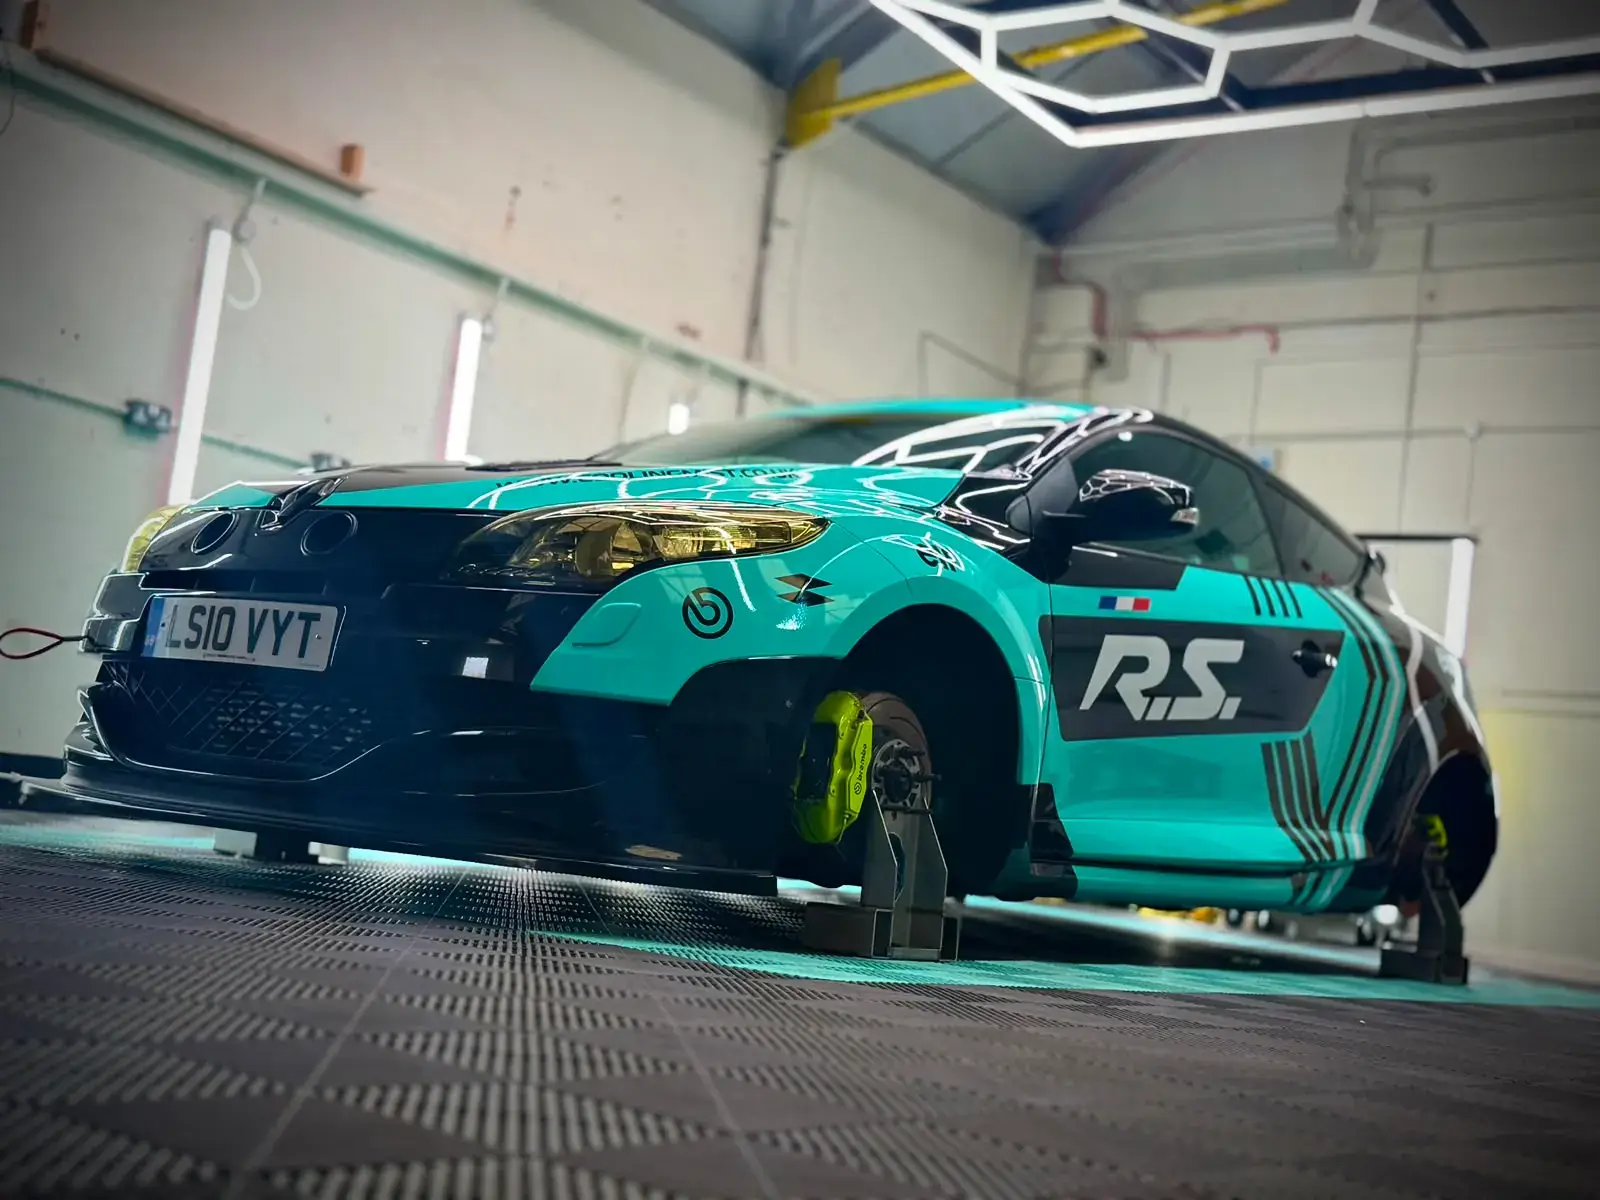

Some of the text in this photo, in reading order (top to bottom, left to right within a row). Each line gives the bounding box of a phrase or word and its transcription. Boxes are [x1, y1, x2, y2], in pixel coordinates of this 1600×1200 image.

[495, 467, 801, 488] W.COOLINGMST.CO.UK
[165, 604, 322, 659] LS10 VYT
[1079, 634, 1245, 721] R.S.
[857, 743, 868, 782] brembo
